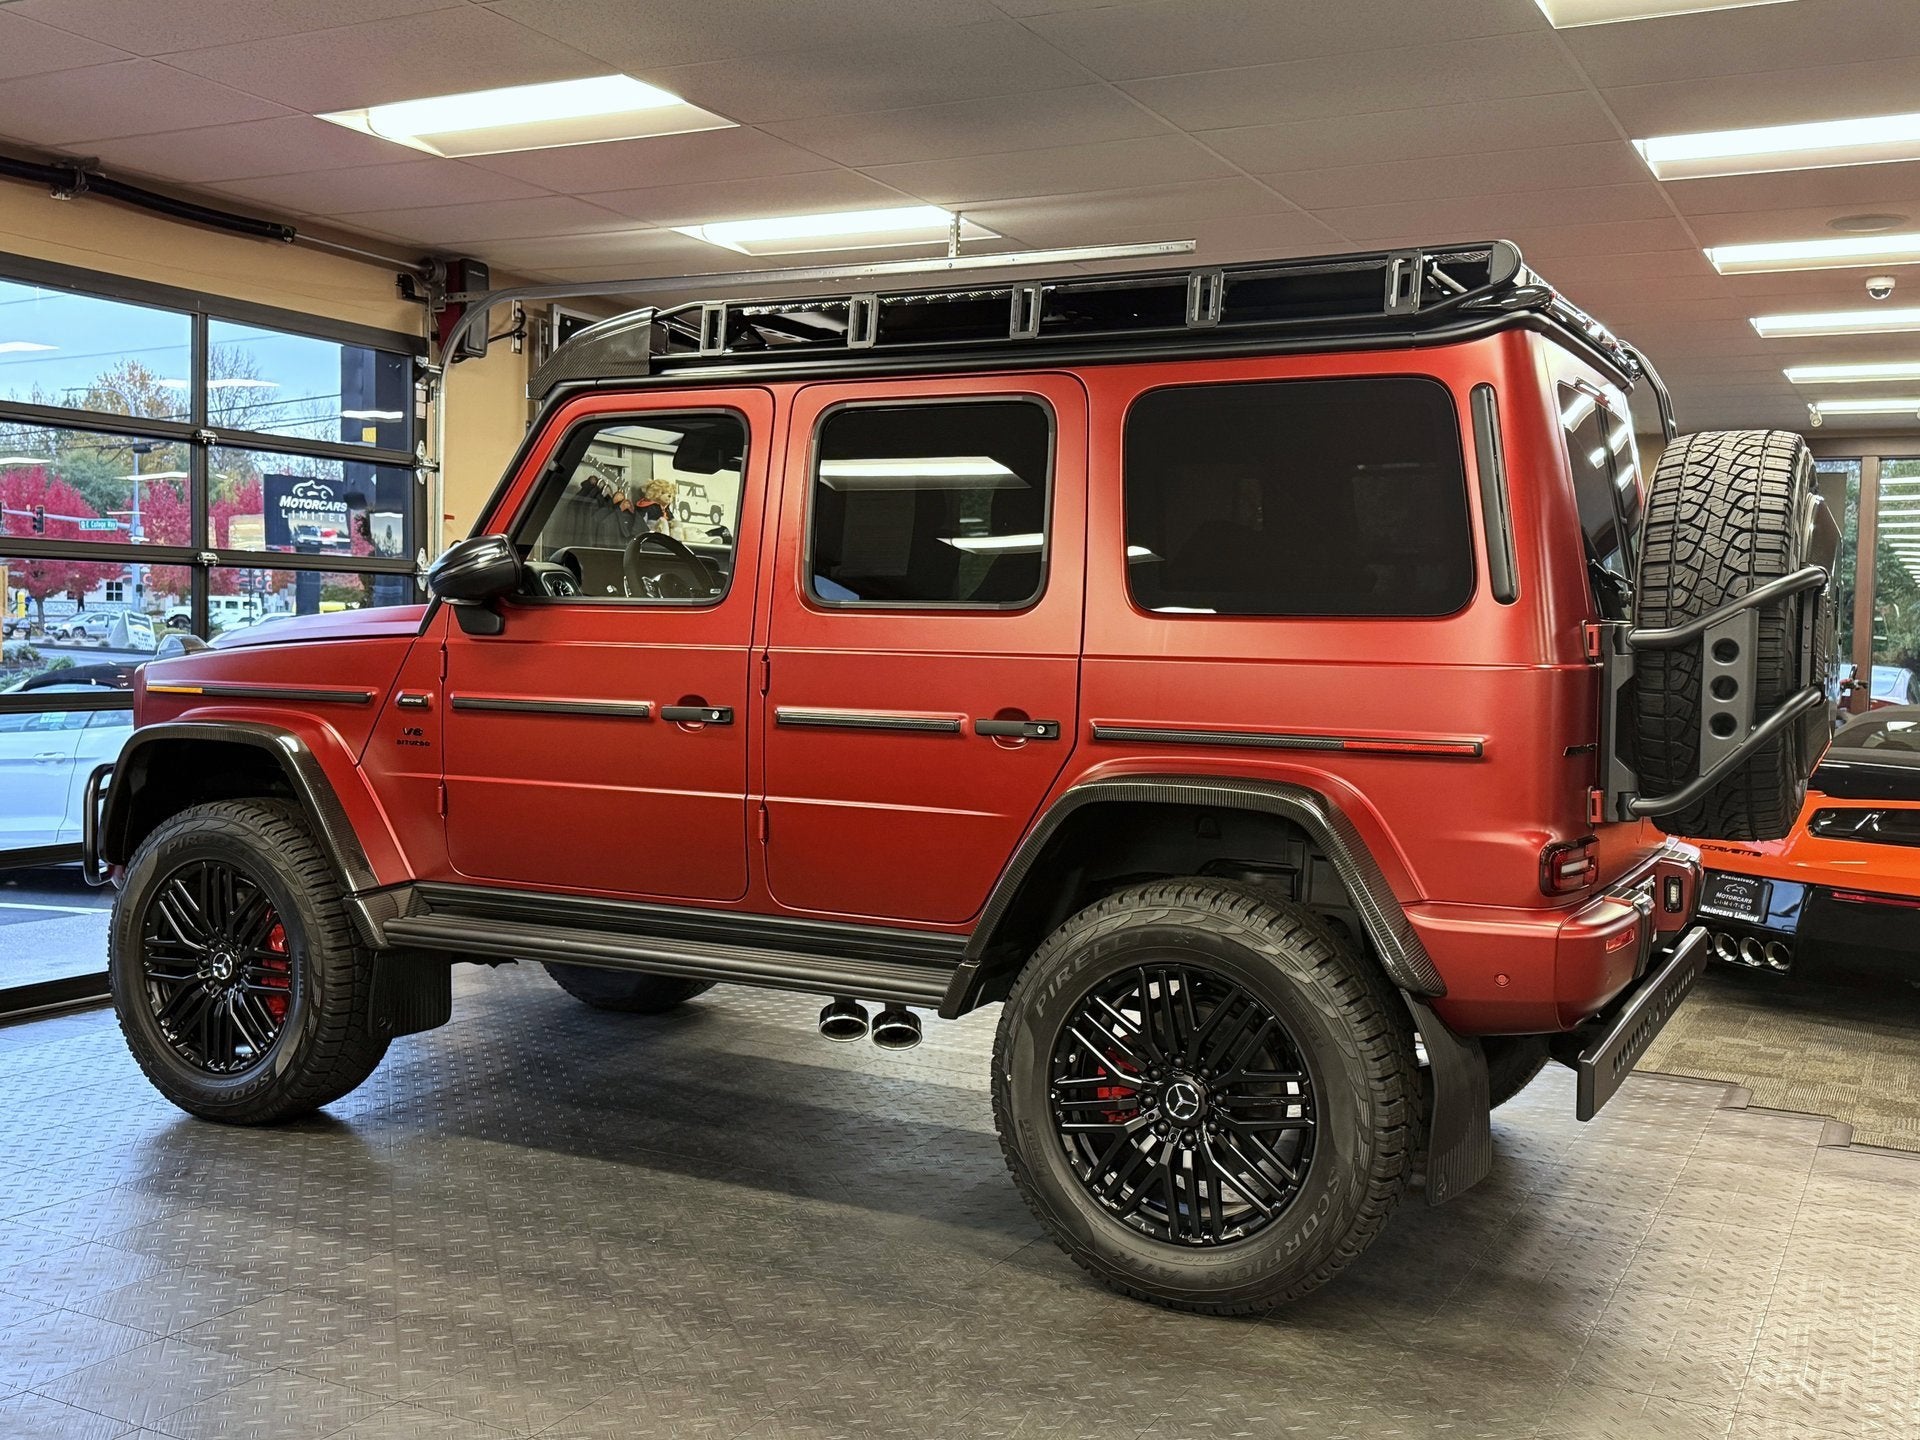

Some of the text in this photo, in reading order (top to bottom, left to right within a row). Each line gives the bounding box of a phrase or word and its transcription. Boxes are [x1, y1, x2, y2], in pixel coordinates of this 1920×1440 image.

[279, 495, 348, 512] MOTORCARS
[281, 508, 346, 523] LIMITED
[1700, 844, 1763, 857] CORVETTE
[1715, 892, 1753, 904] MOTORCARS
[1700, 904, 1760, 923] Motorcars Limited
[1036, 931, 1142, 1018] PIRELLI
[1207, 1166, 1341, 1284] SCORPION
